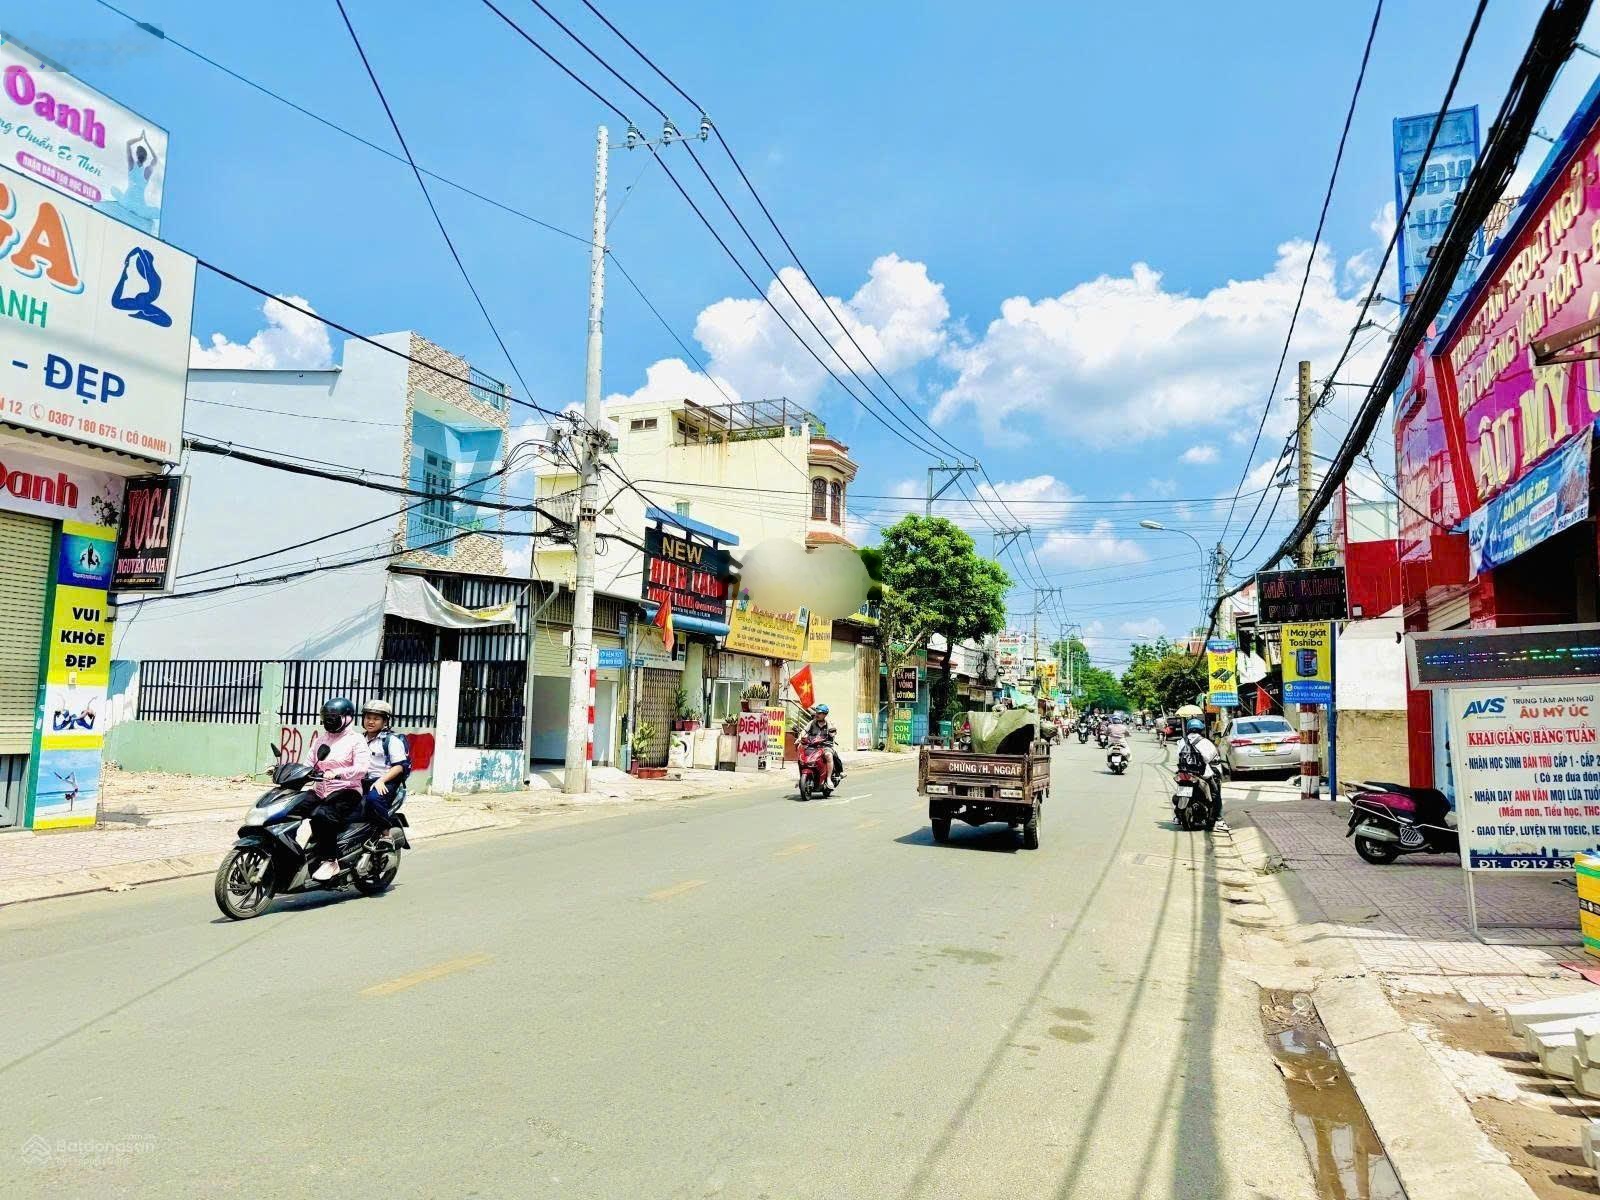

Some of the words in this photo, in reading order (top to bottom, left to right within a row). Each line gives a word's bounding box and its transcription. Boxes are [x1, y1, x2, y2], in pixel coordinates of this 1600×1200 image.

[4, 65, 106, 149] Oanh
[0, 182, 82, 291] A
[44, 353, 125, 404] ĐẸP
[9, 400, 23, 415] 12
[48, 410, 75, 428] 0387
[78, 417, 97, 434] 180
[98, 423, 117, 439] 675
[126, 430, 139, 445] CÔ
[141, 436, 167, 453] OANH
[123, 487, 171, 549] YOGA
[662, 536, 703, 564] NEW
[145, 558, 168, 573] OANH
[1263, 575, 1296, 599] MẮT
[72, 607, 101, 622] VUI
[61, 629, 106, 645] KHỎE
[1290, 629, 1308, 638] Máy
[1308, 629, 1327, 639] giặt
[1289, 639, 1323, 647] Toshiba
[65, 654, 97, 671] ĐẸP
[1538, 696, 1556, 704] TÂM
[1576, 694, 1594, 702] NGỮ
[1462, 697, 1506, 719] AVS
[1520, 703, 1539, 718] ÂU
[1543, 705, 1565, 718] MỸ
[1569, 703, 1589, 717] ÚC
[1468, 732, 1494, 745] KHAI
[1497, 726, 1530, 744] GIẢNG
[1533, 725, 1563, 744] HÀNG
[1566, 722, 1596, 742] TUẦN
[1469, 755, 1487, 771] NHẬN
[1489, 757, 1503, 771] HỌC
[1505, 756, 1521, 769] SINH
[1554, 752, 1568, 768] CẤP
[1581, 751, 1595, 767] CẤP
[1540, 773, 1550, 782] Có
[1553, 774, 1563, 782] xe
[1474, 788, 1496, 804] NHẬN
[1497, 790, 1512, 804] DẠY
[1515, 790, 1531, 801] ANH
[1533, 788, 1548, 801] VĂN
[1550, 790, 1566, 803] MỌI
[1567, 787, 1582, 801] LỨA
[1545, 804, 1562, 816] Tiểu
[1477, 826, 1496, 836] GIAO
[1520, 824, 1546, 837] LUYỆN
[1548, 826, 1560, 835] THI
[1478, 860, 1501, 869] ĐT:
[1511, 860, 1548, 869] 0919
[1553, 860, 1576, 869] 53
